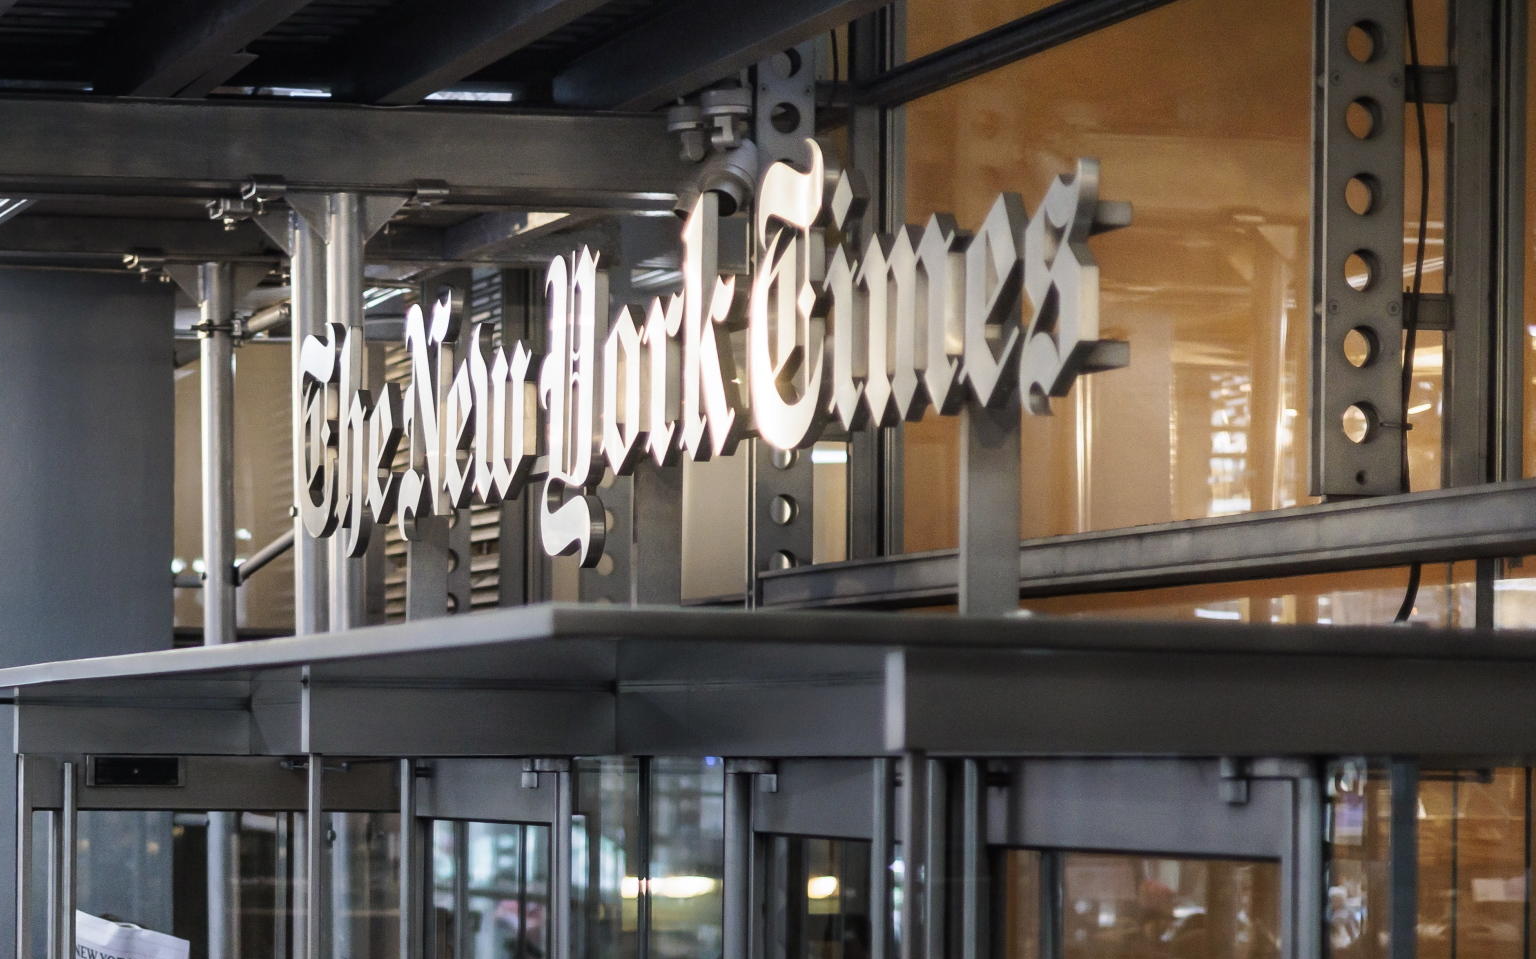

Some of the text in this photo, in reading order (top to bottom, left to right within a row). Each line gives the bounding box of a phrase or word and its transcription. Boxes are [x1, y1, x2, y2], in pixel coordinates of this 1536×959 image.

[298, 137, 1100, 568] The New York Times
